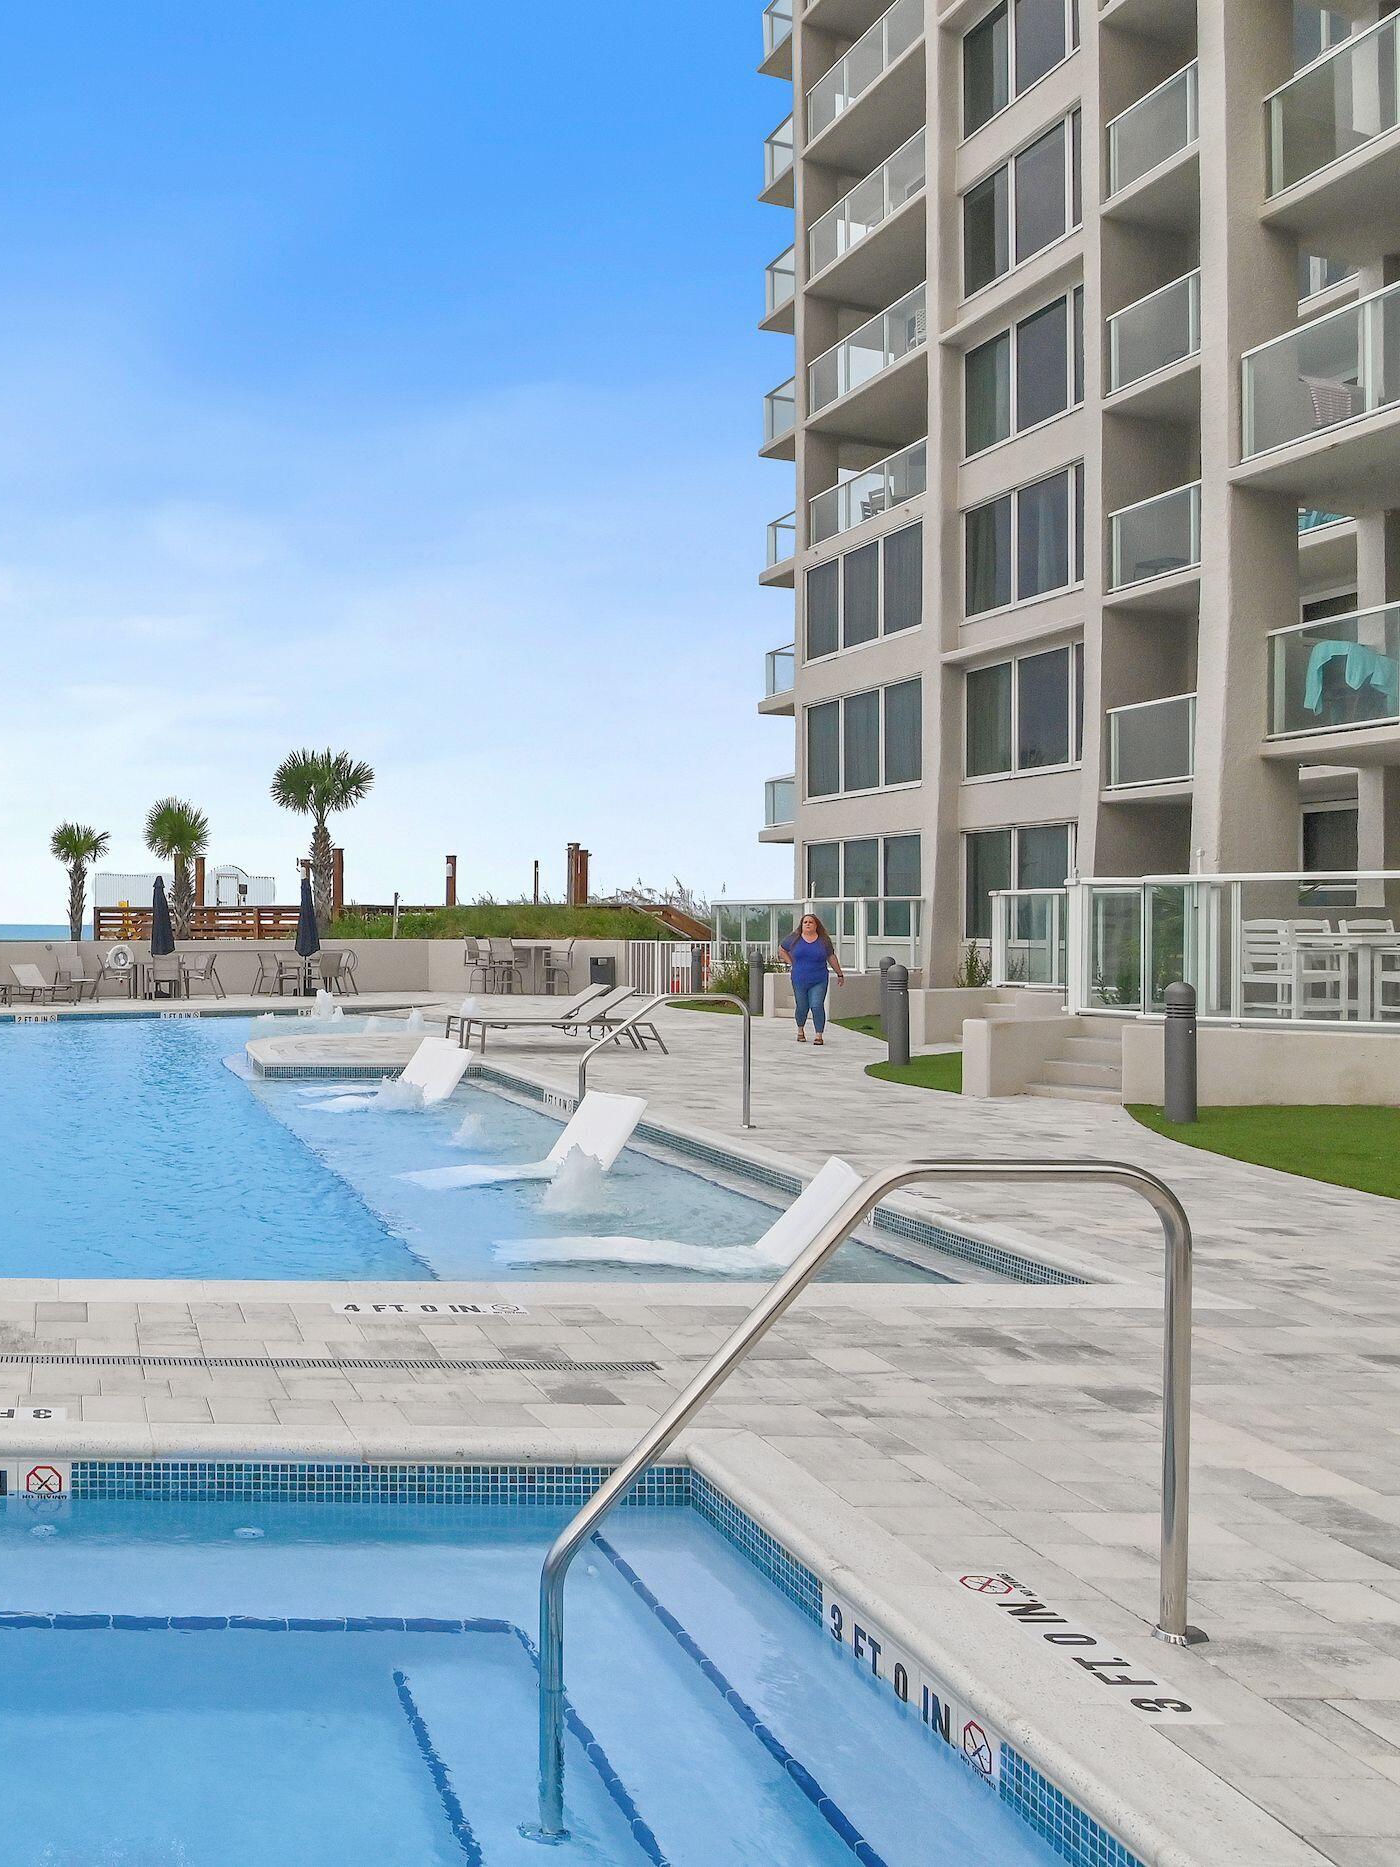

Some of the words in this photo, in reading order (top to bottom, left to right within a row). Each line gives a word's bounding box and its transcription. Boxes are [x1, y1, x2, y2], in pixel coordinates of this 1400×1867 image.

[343, 1304, 361, 1312] 4
[420, 1304, 439, 1312] 0
[32, 1408, 53, 1419] 3
[995, 1599, 1070, 1623] IN.
[1043, 1633, 1098, 1645] 0
[829, 1603, 843, 1643] 3
[854, 1622, 883, 1681] FT.
[893, 1662, 908, 1703] 0
[922, 1684, 957, 1750] IN.
[1071, 1656, 1159, 1686] FT.
[1129, 1697, 1193, 1713] 3
